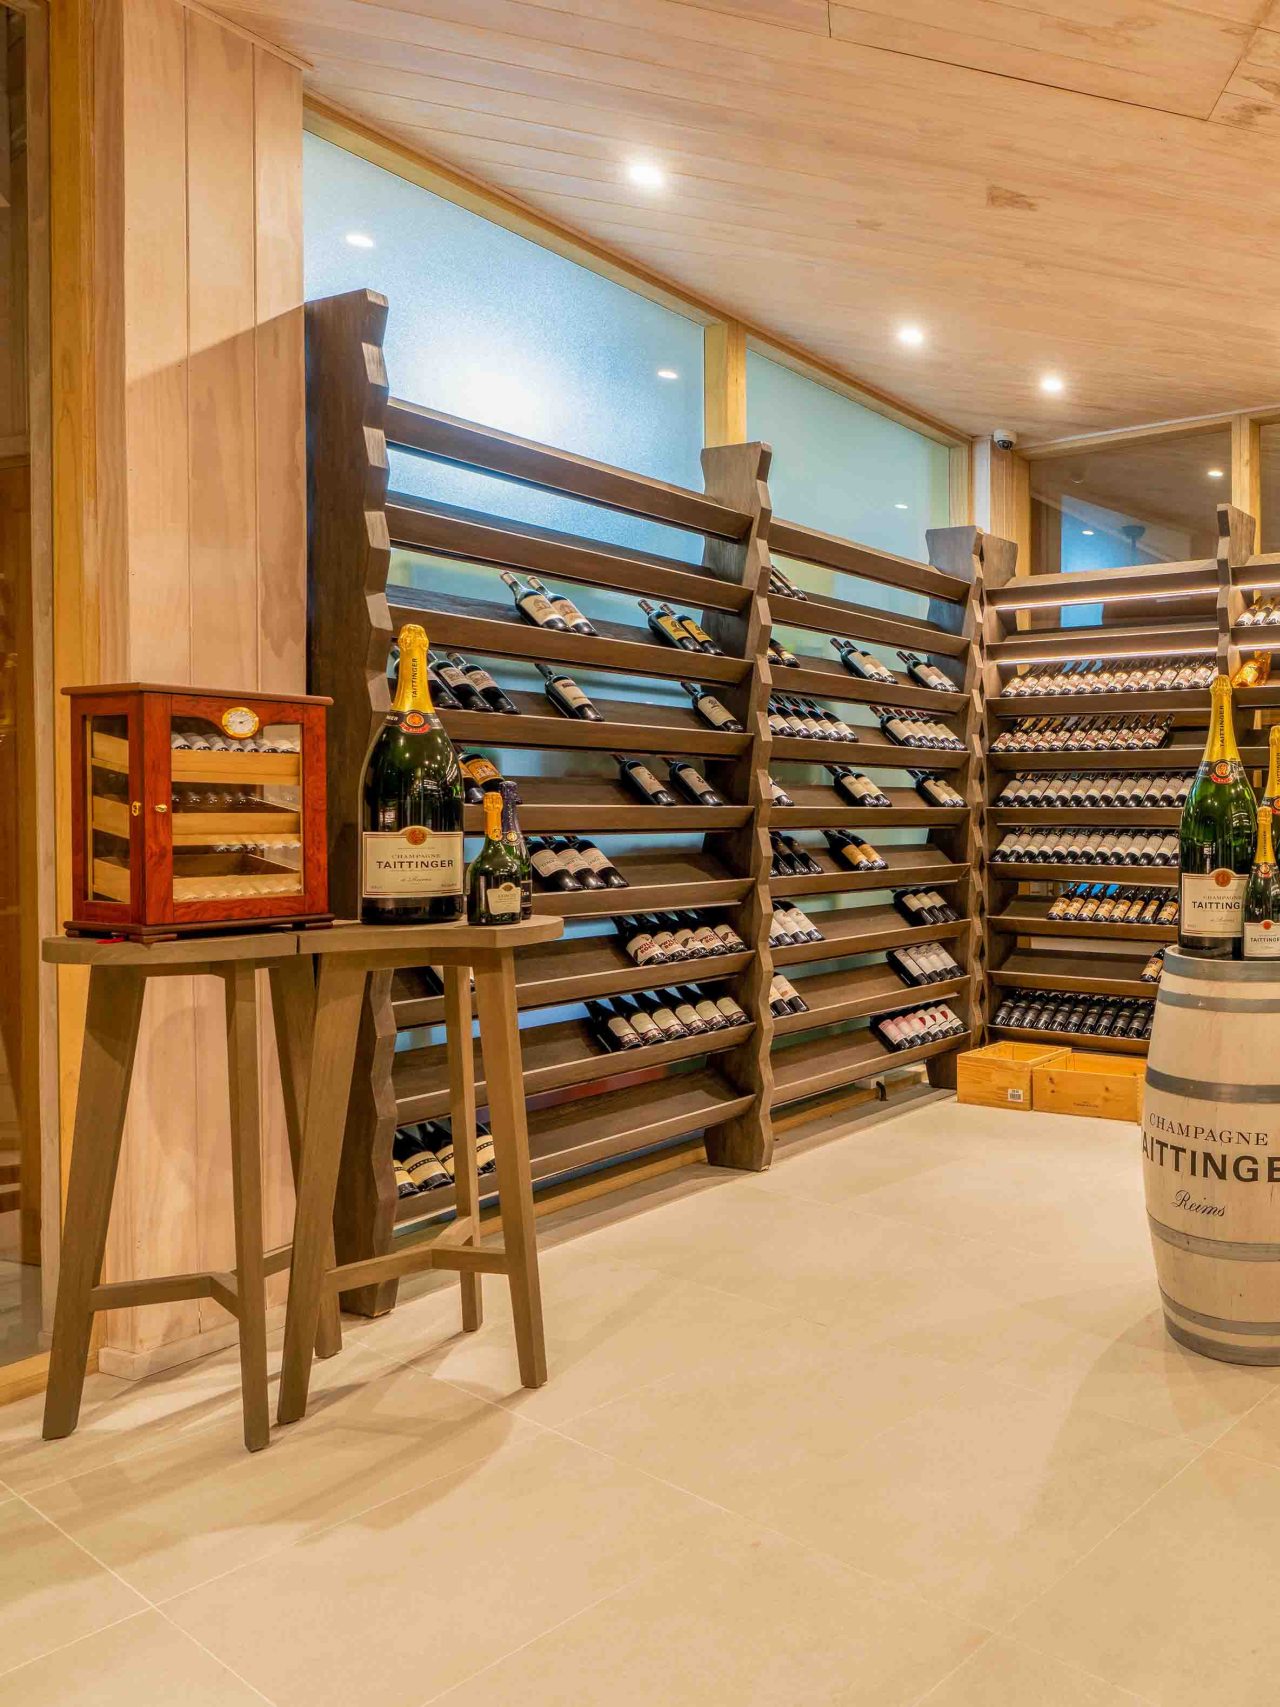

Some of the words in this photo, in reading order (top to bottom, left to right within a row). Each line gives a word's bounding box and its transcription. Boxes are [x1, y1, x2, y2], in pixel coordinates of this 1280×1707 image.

[376, 859, 454, 869] TAITTINGER
[1191, 901, 1241, 910] TAITTING
[1150, 1112, 1269, 1146] CHAMPAGNE
[1171, 1189, 1226, 1218] Reims
